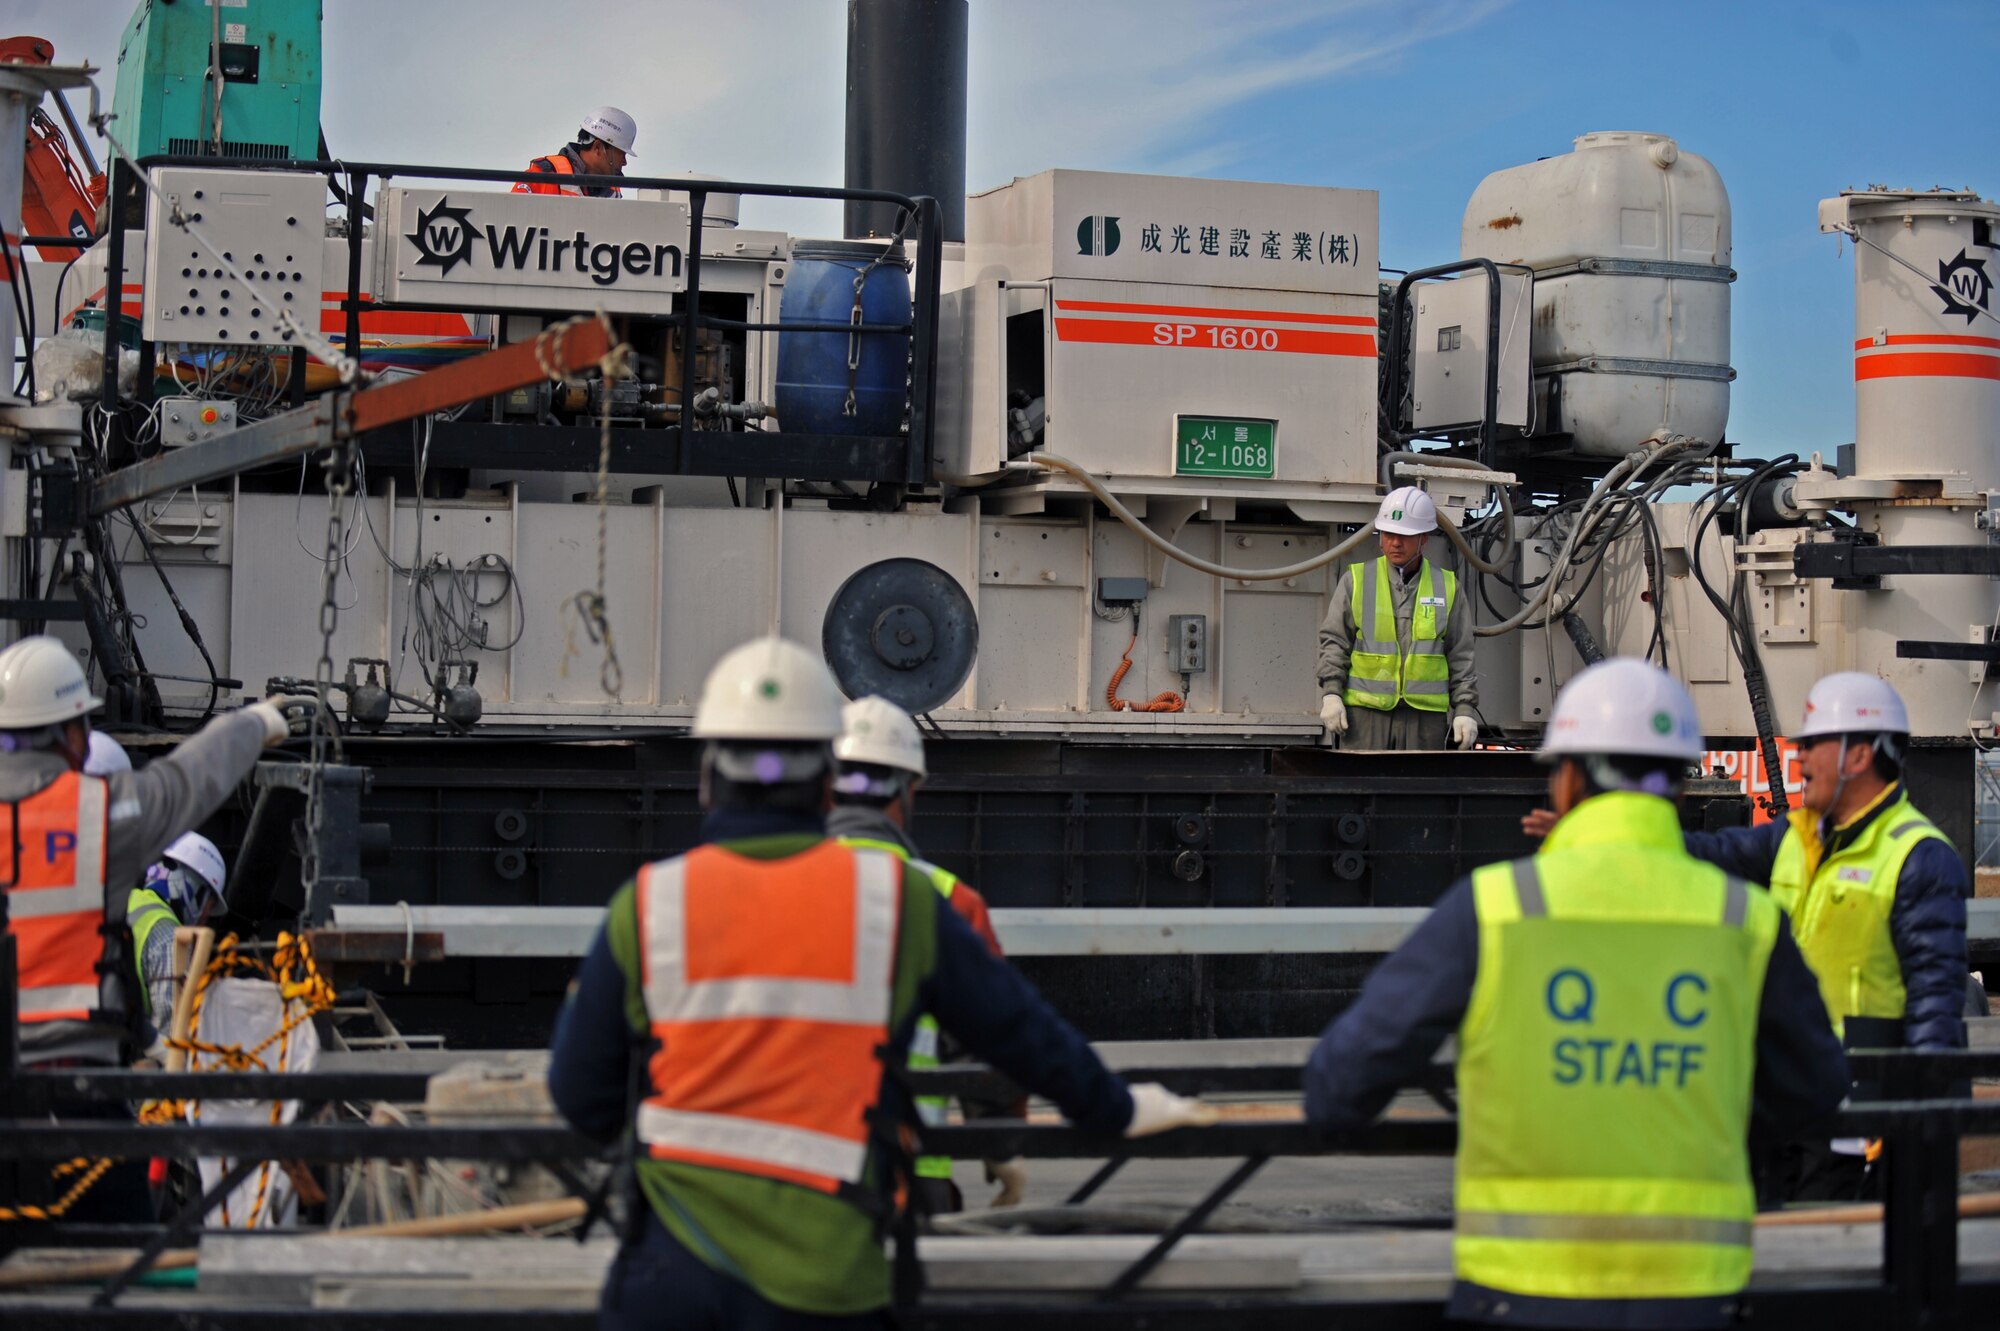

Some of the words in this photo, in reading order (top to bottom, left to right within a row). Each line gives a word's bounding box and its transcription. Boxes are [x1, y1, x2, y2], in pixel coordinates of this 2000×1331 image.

[428, 226, 460, 252] W
[485, 224, 682, 285] Wirtgen
[1952, 275, 1978, 300] W
[1153, 323, 1197, 345] SP
[1206, 327, 1279, 350] 1600
[1185, 443, 1267, 467] 12-1068
[1547, 969, 1594, 1024] Q
[1665, 973, 1709, 1028] C
[1553, 1037, 1707, 1088] STAFF
